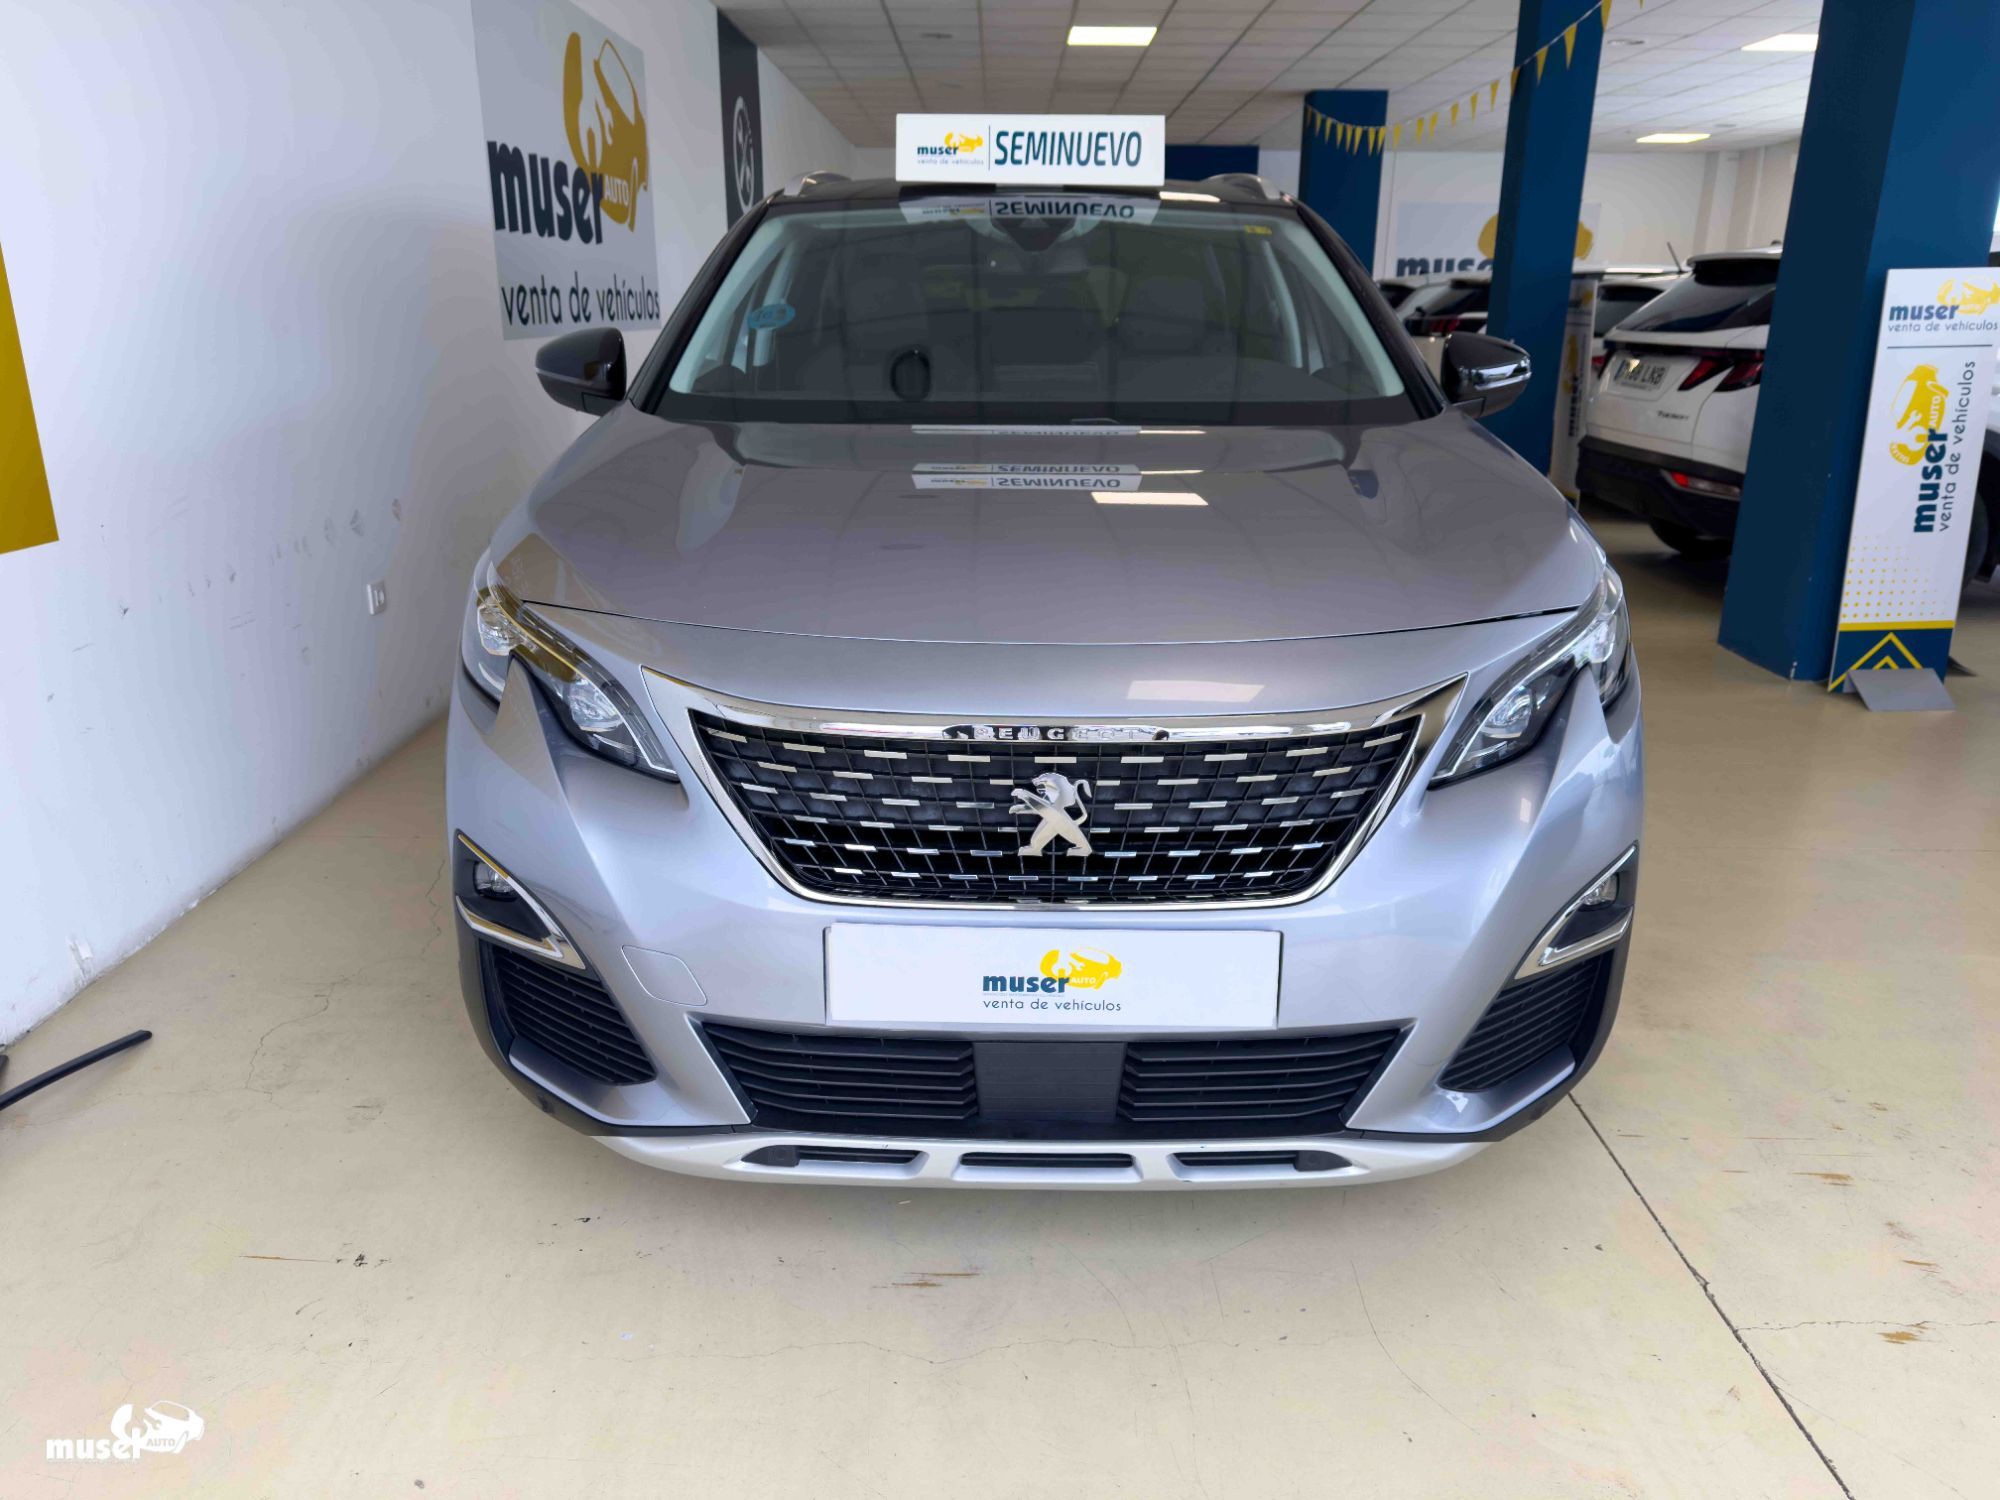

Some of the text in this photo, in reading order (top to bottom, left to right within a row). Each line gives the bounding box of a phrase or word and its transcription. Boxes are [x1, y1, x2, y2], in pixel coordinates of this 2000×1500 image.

[917, 146, 959, 155] muser
[994, 131, 1142, 167] SEMINUEVO
[486, 140, 604, 244] muser
[604, 175, 629, 206] AUTO
[501, 270, 661, 326] venta de vehículos
[1889, 304, 1960, 321] muser
[1888, 319, 1998, 332] venta de vehículos
[1929, 395, 1941, 427] AUTO
[1939, 361, 1976, 532] venta de vehículos
[1913, 428, 1949, 533] muser
[982, 976, 1070, 993] muser
[983, 998, 1122, 1012] venta de vehículos
